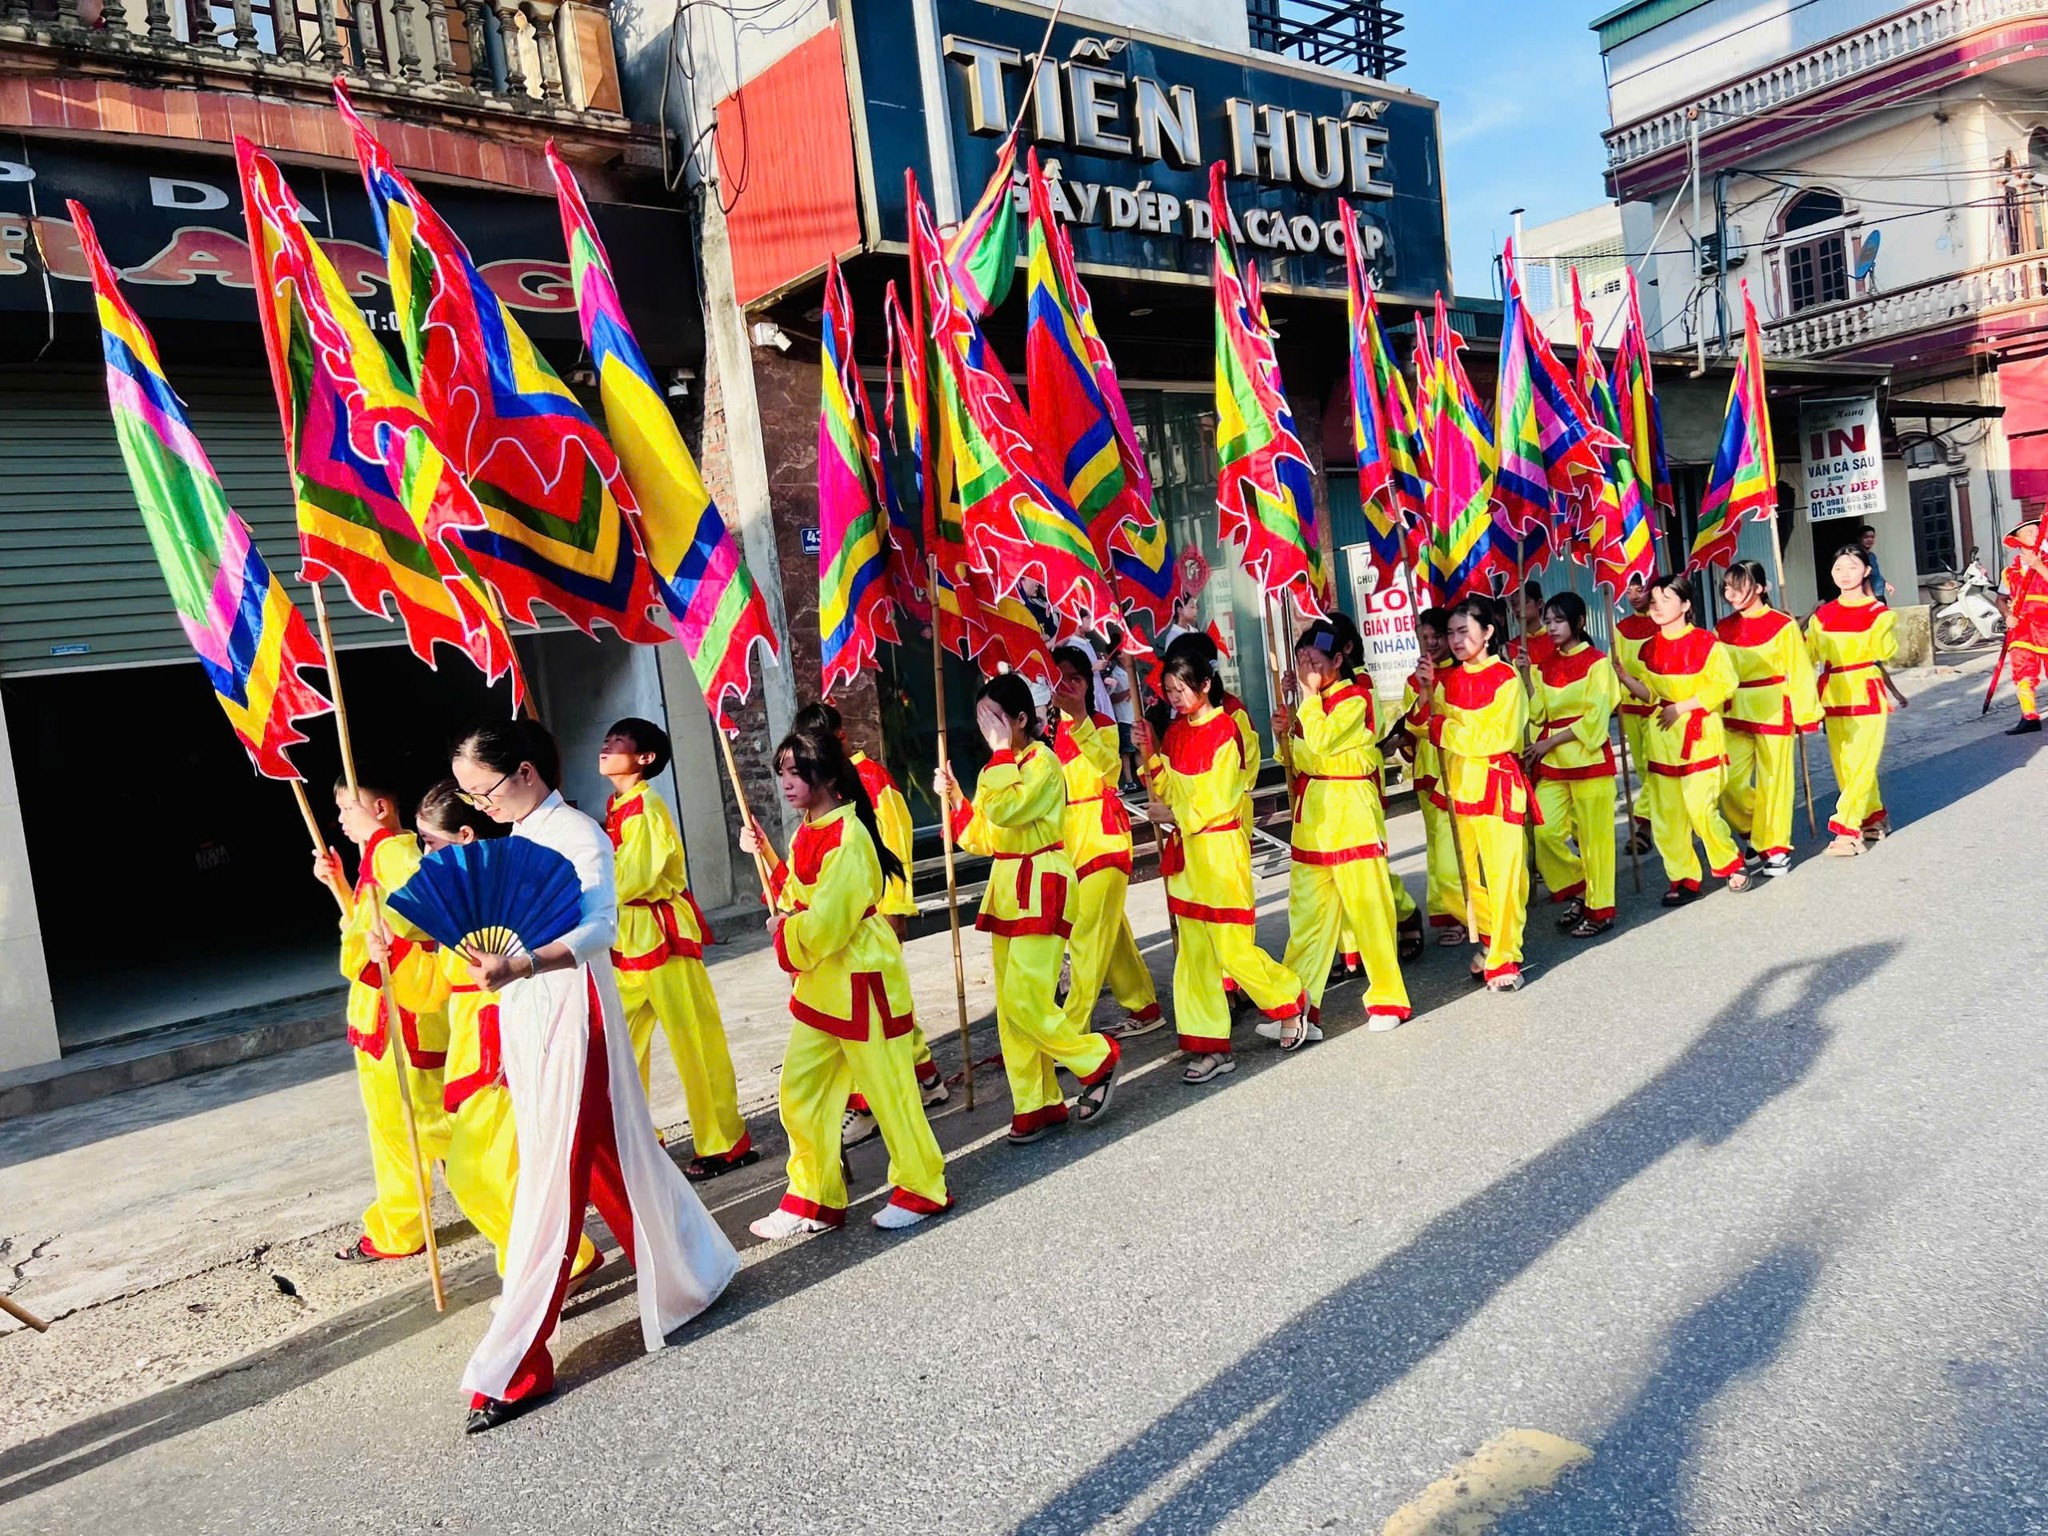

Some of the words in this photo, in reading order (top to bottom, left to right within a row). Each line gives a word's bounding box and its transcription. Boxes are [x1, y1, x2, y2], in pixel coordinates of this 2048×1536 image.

[943, 34, 1201, 166] TIẾN
[1226, 97, 1394, 197] HUẾ
[1105, 180, 1181, 234] DÉP
[1243, 208, 1320, 252] CAO
[1320, 210, 1384, 260] CP
[1810, 425, 1866, 460] IN
[1834, 457, 1849, 474] CÁ
[1374, 634, 1416, 655] NHẬN
